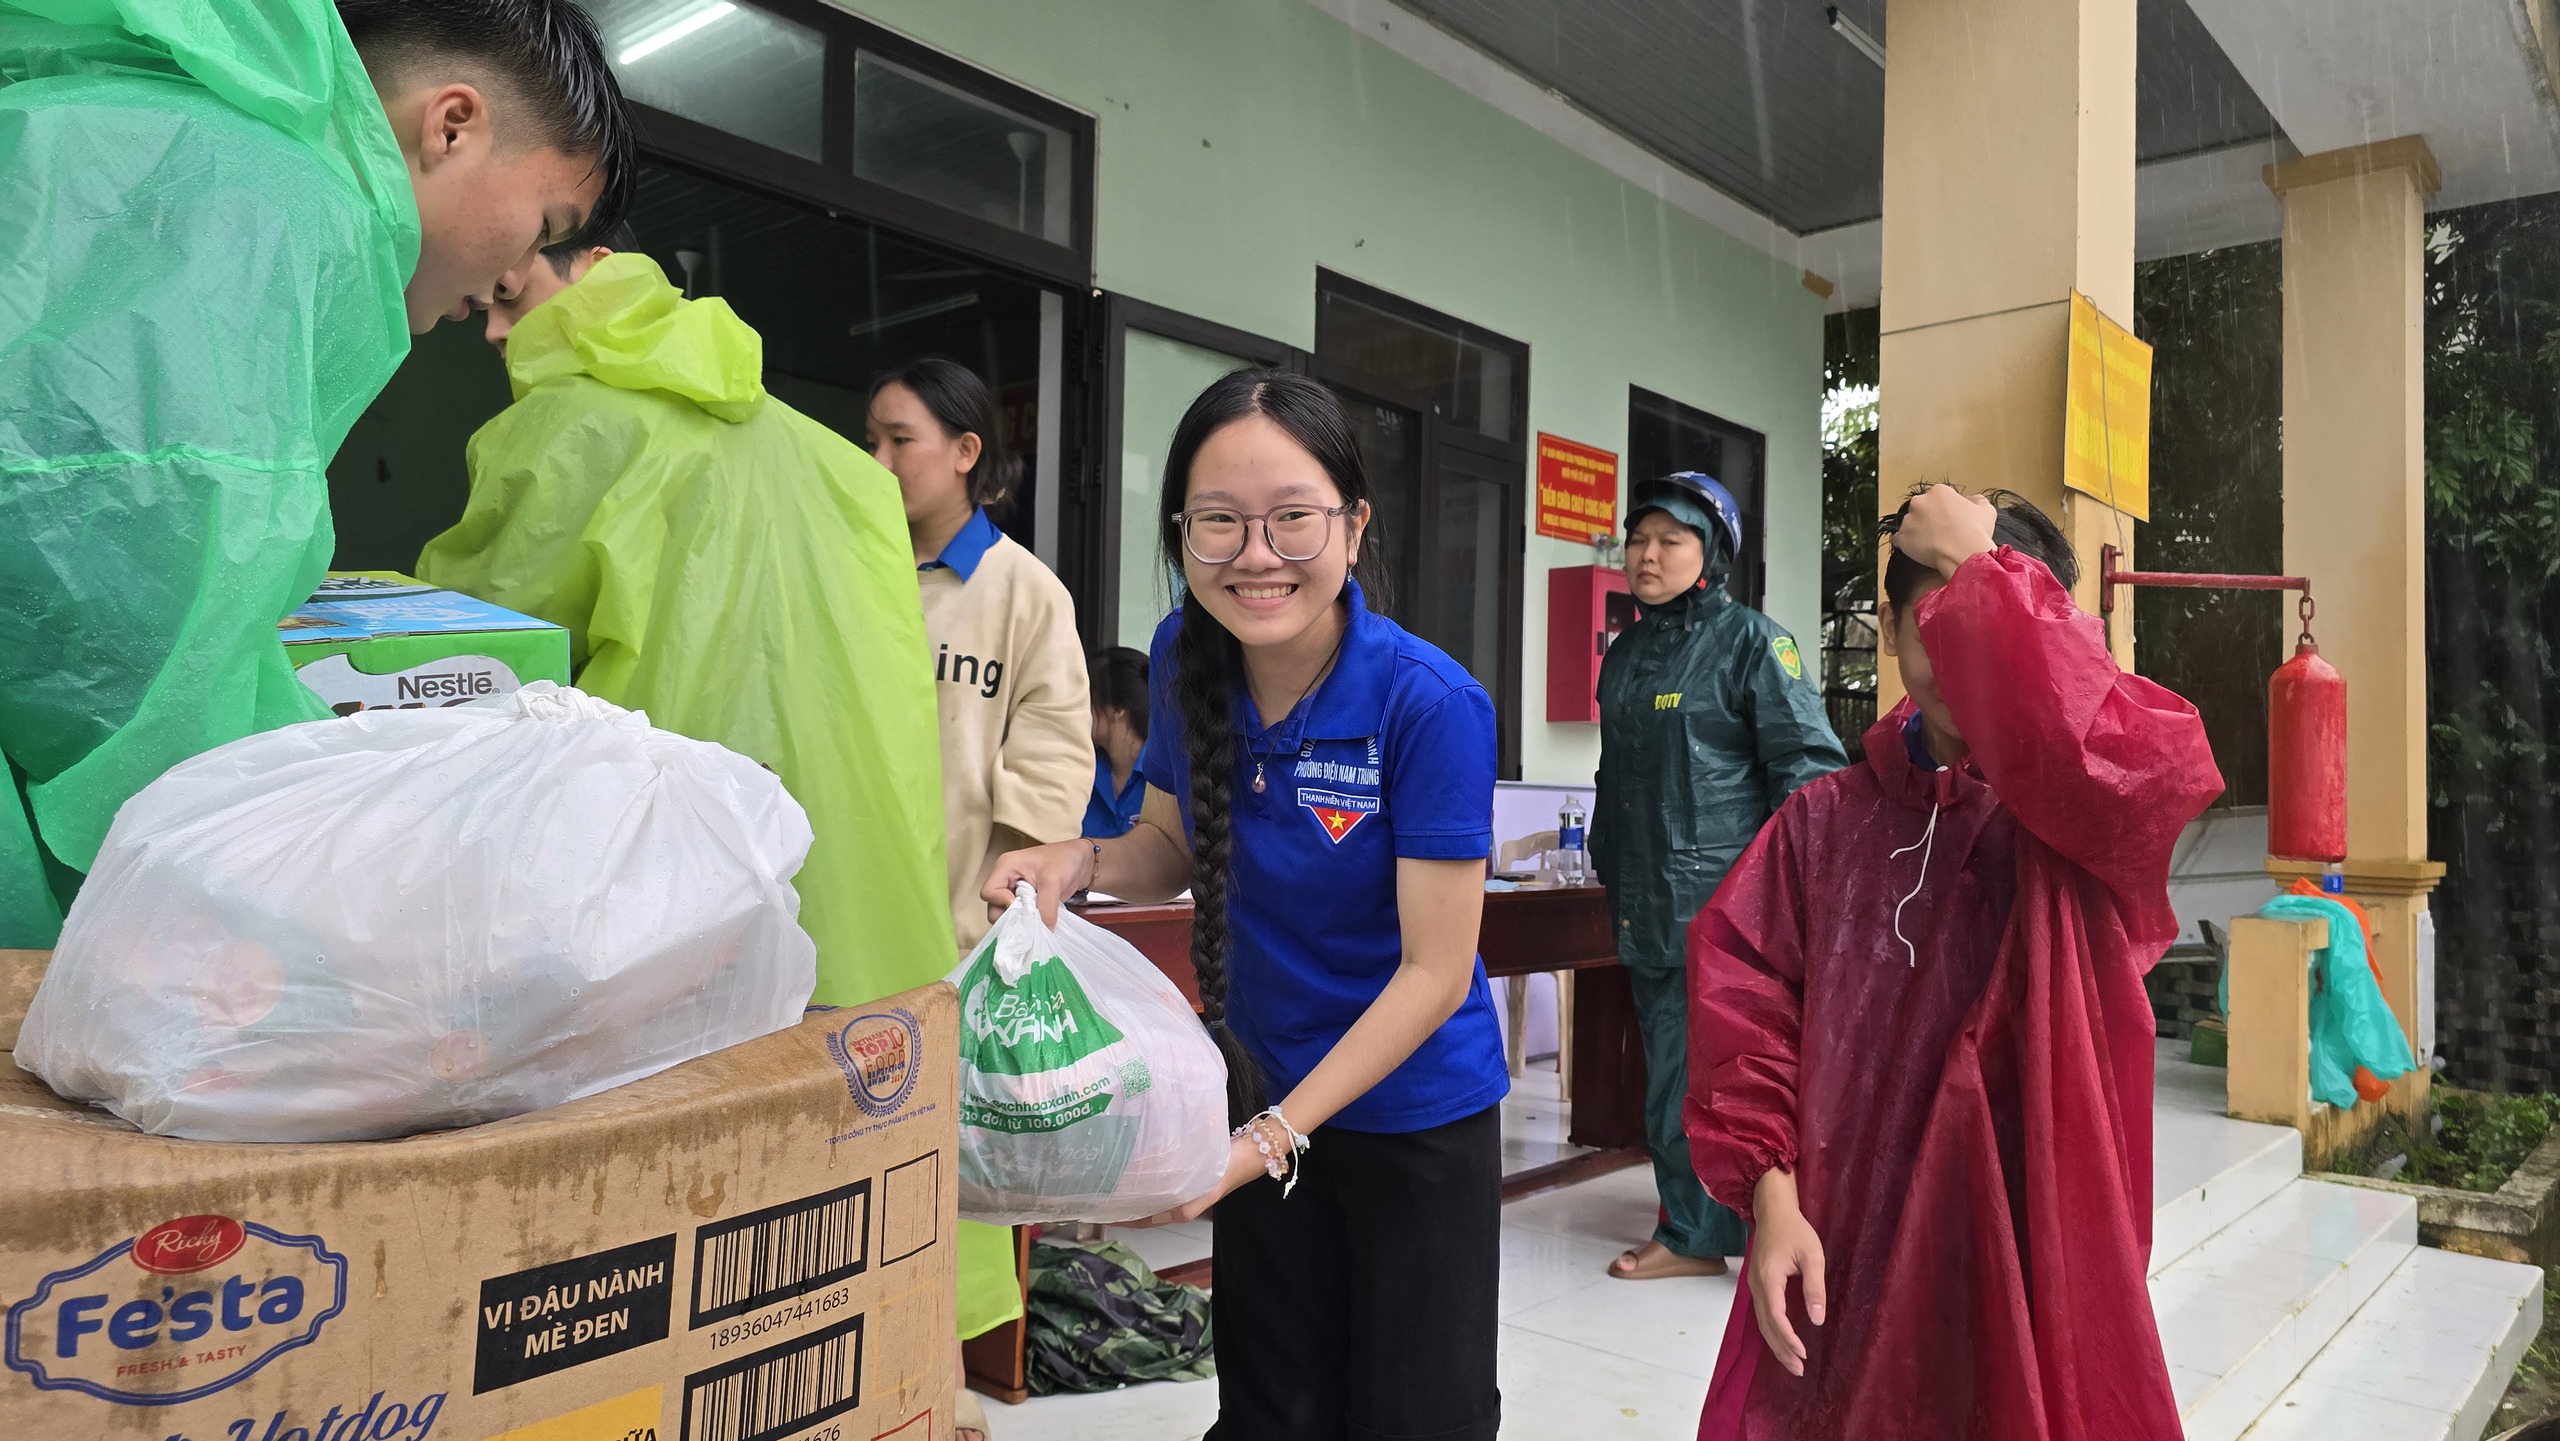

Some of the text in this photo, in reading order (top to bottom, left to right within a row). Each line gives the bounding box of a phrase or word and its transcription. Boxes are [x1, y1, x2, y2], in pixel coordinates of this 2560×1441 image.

[398, 670, 493, 700] Nestlé
[1338, 764, 1357, 784] NAM
[1357, 767, 1380, 786] TRUNG
[1301, 792, 1325, 804] THANH
[1357, 801, 1376, 809] NAM
[855, 1026, 904, 1058] TOP 10
[864, 1049, 906, 1073] FOOD
[484, 1261, 665, 1333] VỊ ĐẬU NÀNH
[524, 1307, 630, 1360] MÈ ĐEN
[710, 1287, 850, 1351] 18936047441683
[116, 1344, 248, 1378] FRESH & TASTY
